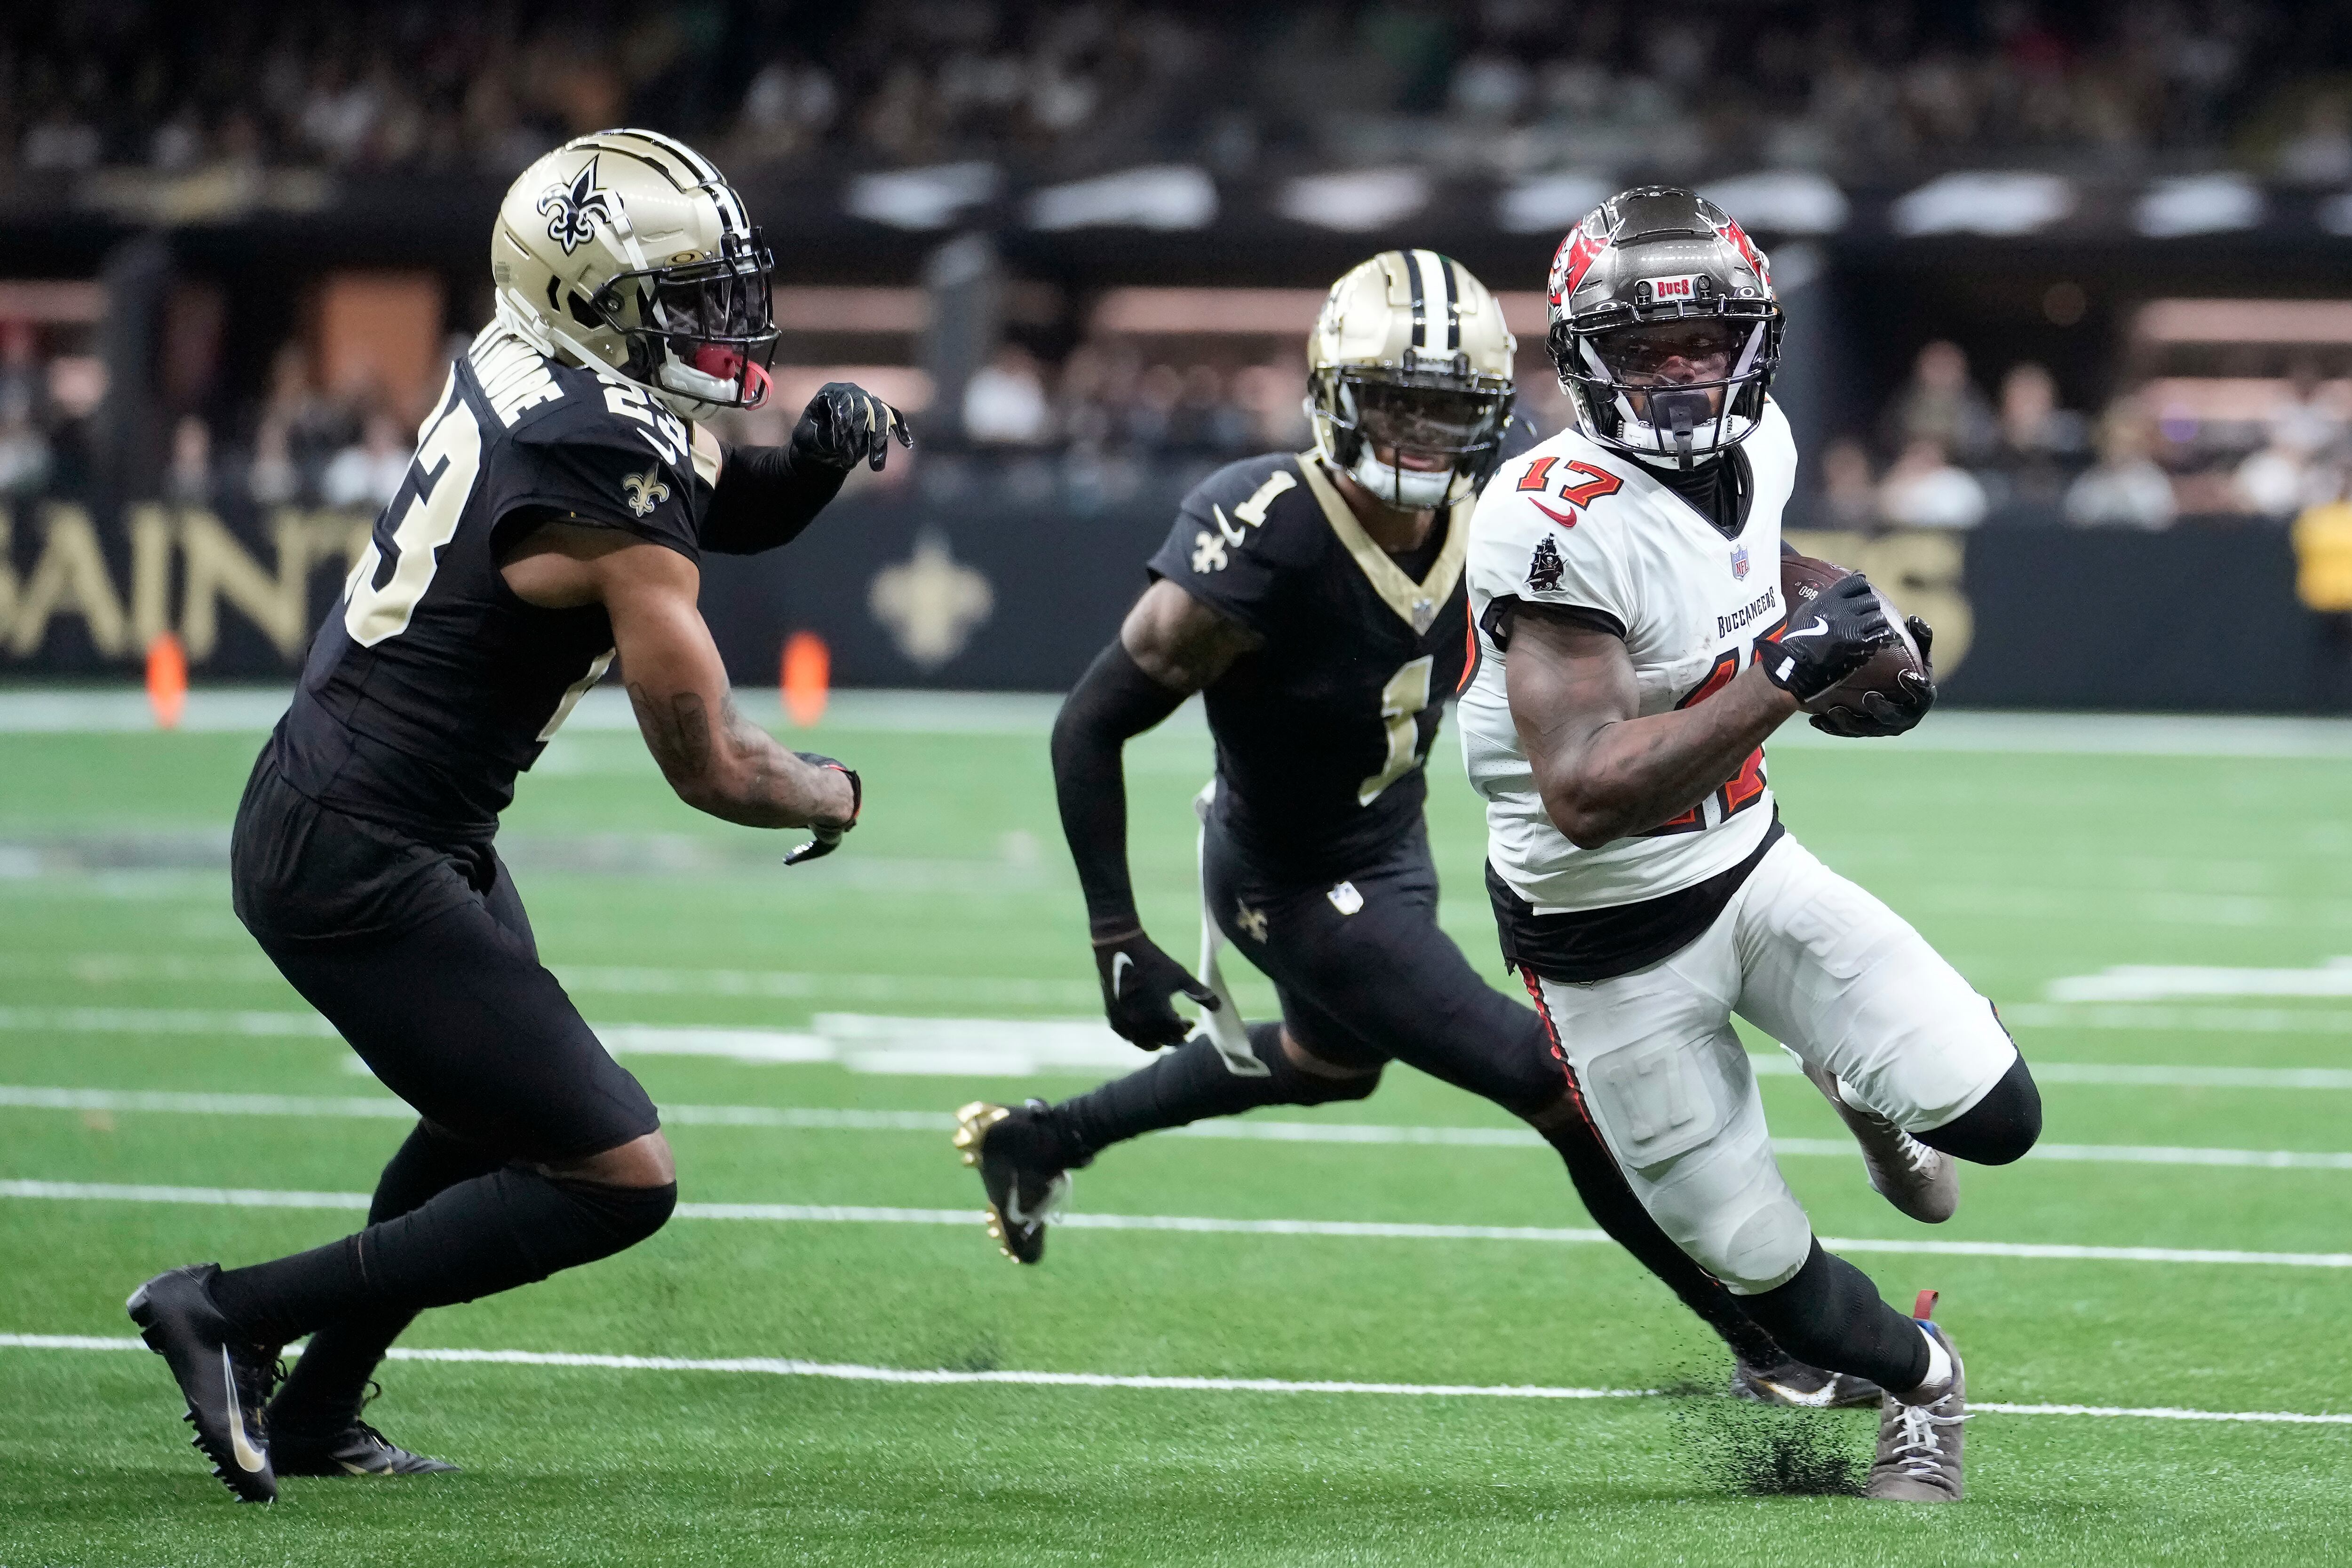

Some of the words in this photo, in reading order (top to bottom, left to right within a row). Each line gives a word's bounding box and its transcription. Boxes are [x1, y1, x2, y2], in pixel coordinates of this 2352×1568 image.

[1657, 279, 1689, 298] BUCS
[1234, 470, 1297, 528] 1
[1516, 456, 1624, 511] 17
[0, 500, 376, 657] AIN
[1736, 560, 1748, 574] NFL
[1717, 586, 1775, 638] BUCCANEERS
[1358, 654, 1434, 807] 1
